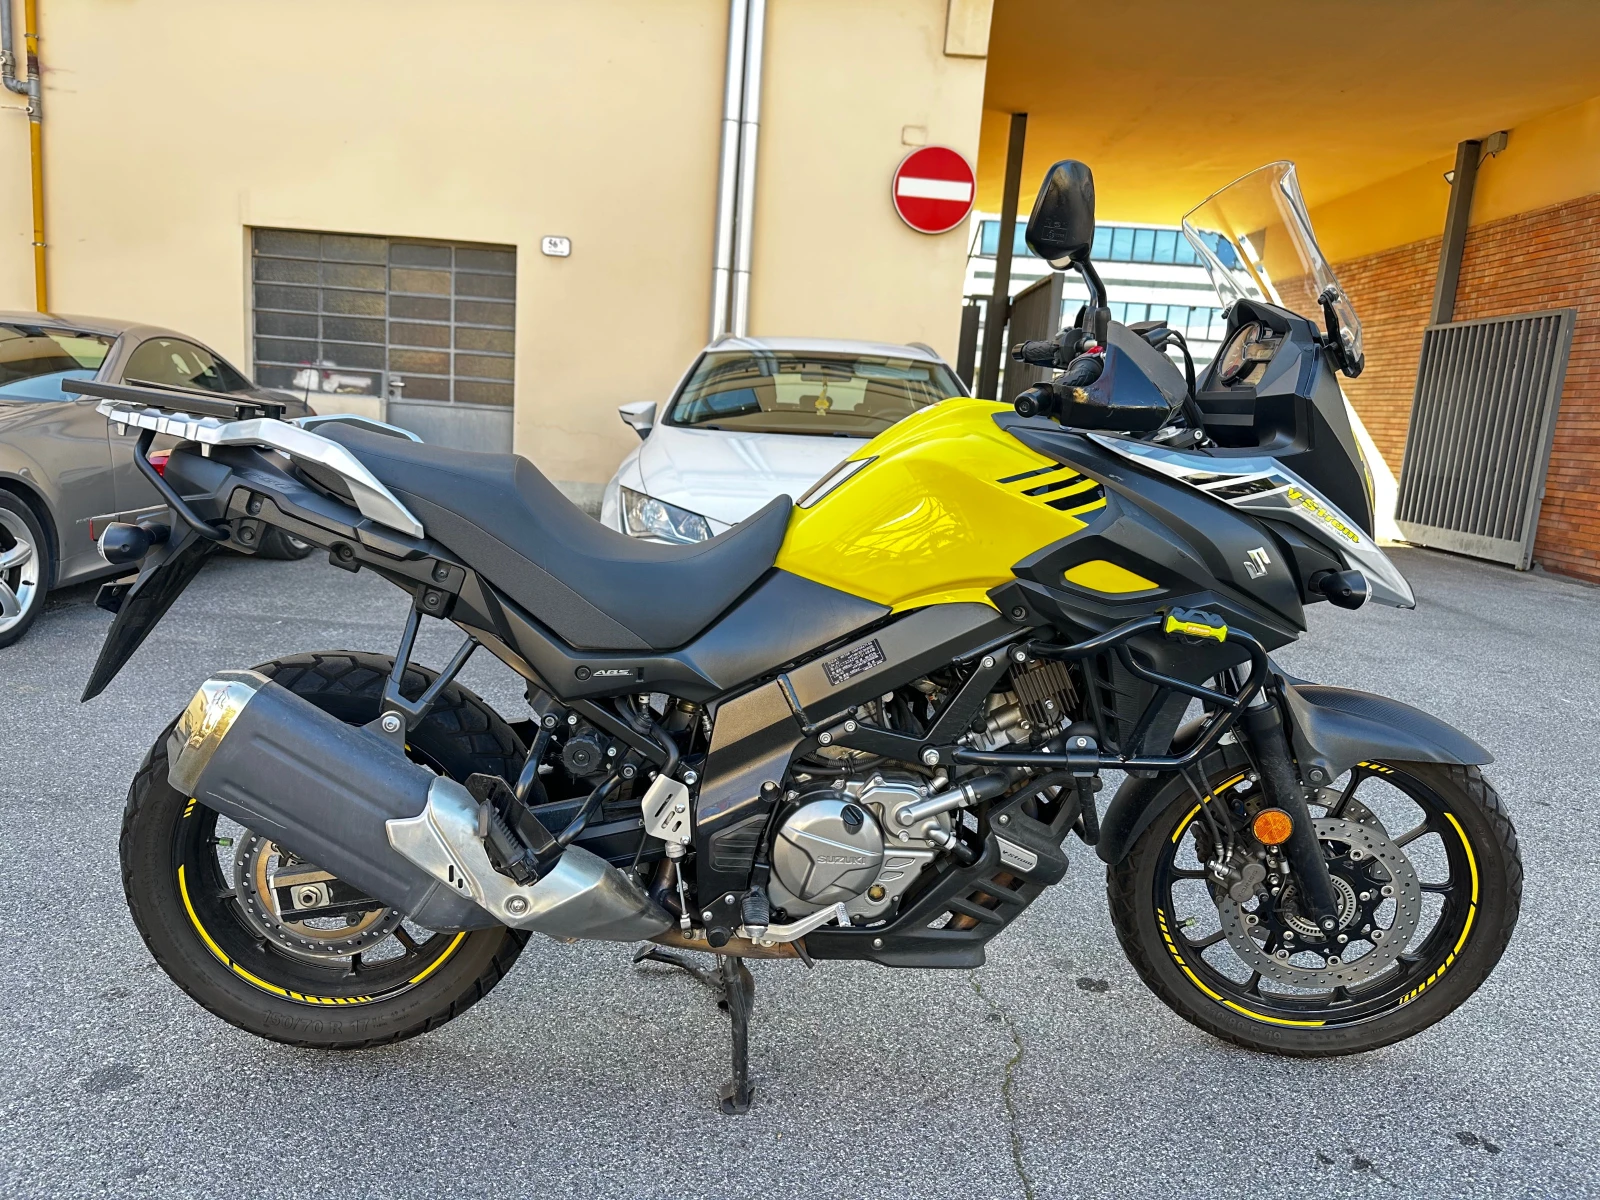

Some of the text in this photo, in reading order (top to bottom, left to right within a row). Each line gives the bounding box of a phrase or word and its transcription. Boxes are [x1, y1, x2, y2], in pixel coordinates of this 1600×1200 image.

[1287, 487, 1359, 543] V-Strom
[593, 669, 630, 677] ABS
[817, 855, 866, 866] SUZUKI
[263, 1010, 324, 1031] 150/70
[330, 1021, 343, 1034] R
[350, 1018, 370, 1032] 17
